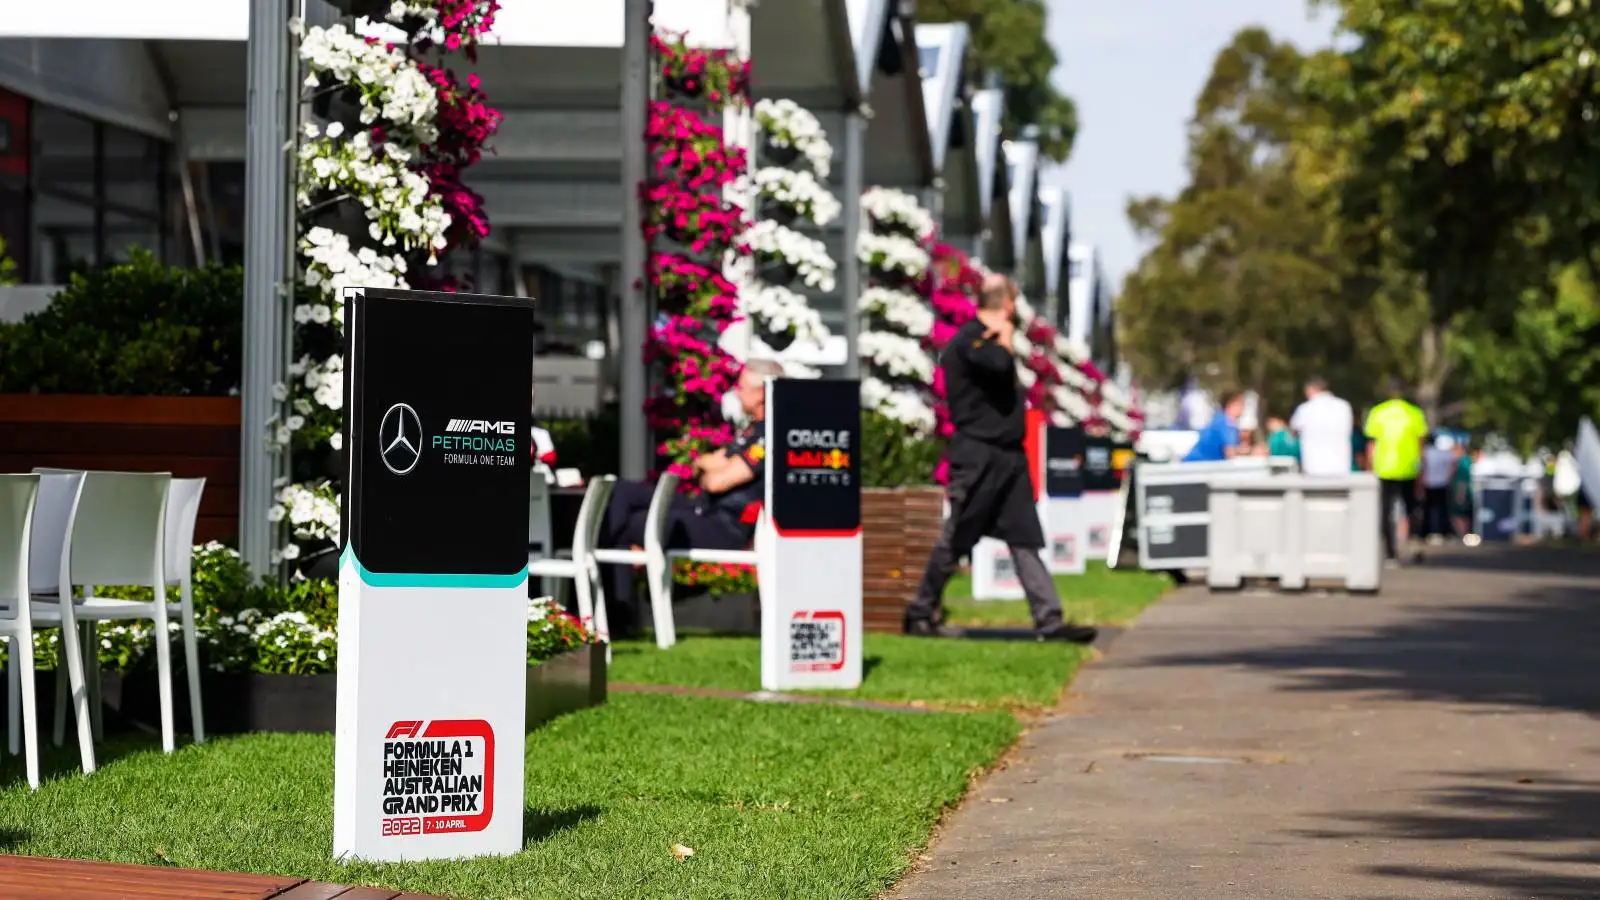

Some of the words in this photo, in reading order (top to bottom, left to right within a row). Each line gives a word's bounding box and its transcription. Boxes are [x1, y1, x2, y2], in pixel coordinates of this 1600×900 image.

[467, 420, 515, 434] AMG
[432, 435, 515, 451] PETRONAS
[786, 429, 850, 448] ORACLE
[444, 453, 478, 465] FORMULA
[480, 454, 495, 466] ONE
[497, 455, 515, 467] TEAM
[385, 720, 424, 738] F1
[384, 740, 462, 760] FORMULA
[464, 740, 474, 757] 1
[383, 758, 462, 778] HEINEKEN
[383, 775, 482, 795] AUSTRALIAN
[382, 795, 439, 815] GRAND
[441, 794, 478, 812] PRIX
[382, 817, 421, 836] 2022
[426, 821, 431, 829] 7
[435, 820, 445, 829] 10
[446, 819, 466, 829] APRIL
